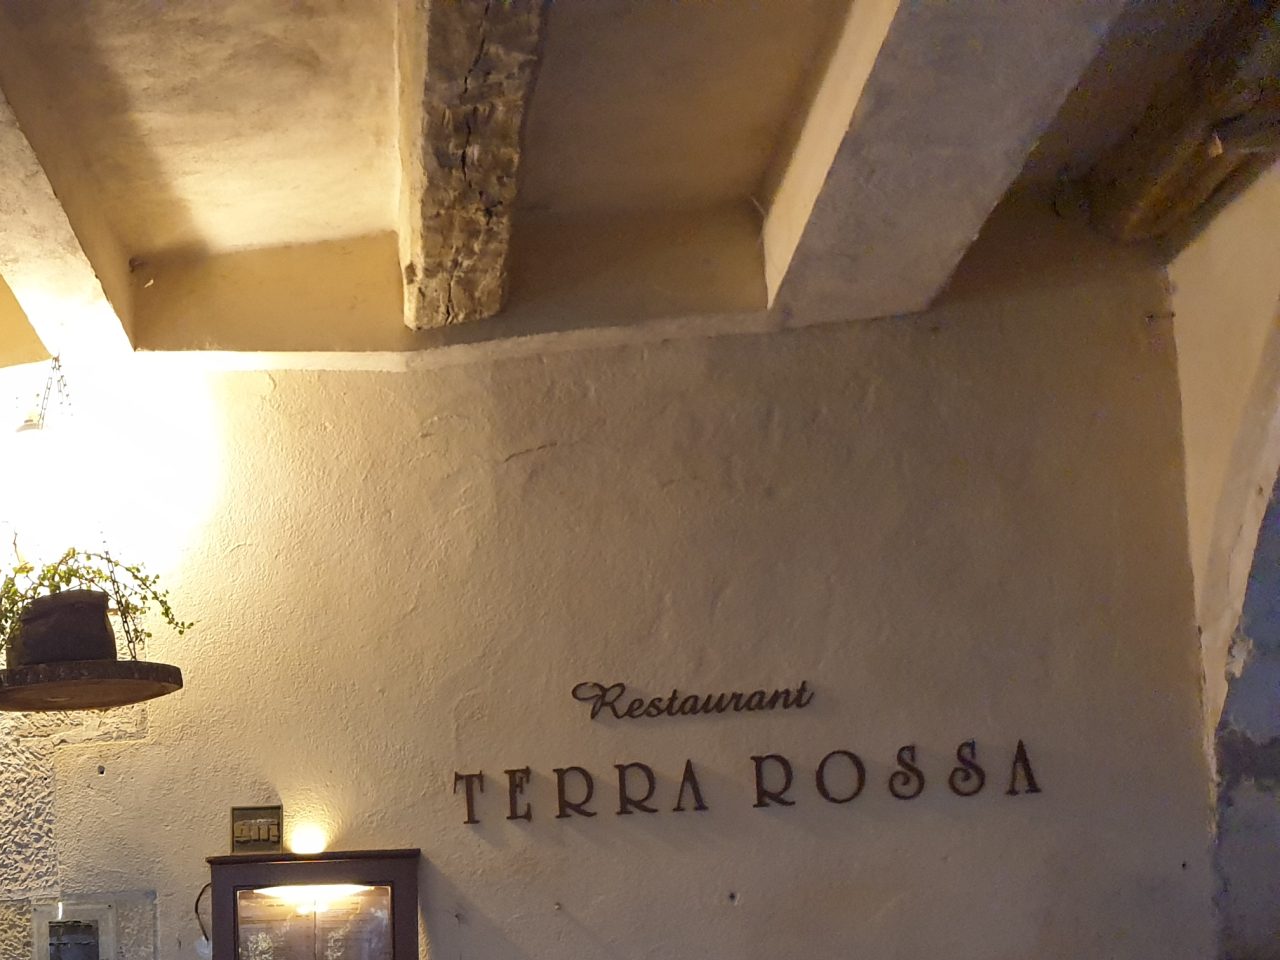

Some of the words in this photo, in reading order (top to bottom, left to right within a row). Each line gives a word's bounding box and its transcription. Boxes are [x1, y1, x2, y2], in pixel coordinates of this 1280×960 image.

[571, 680, 815, 720] Restaurant
[453, 758, 709, 826] TERRA
[750, 739, 1042, 808] ROSSA
